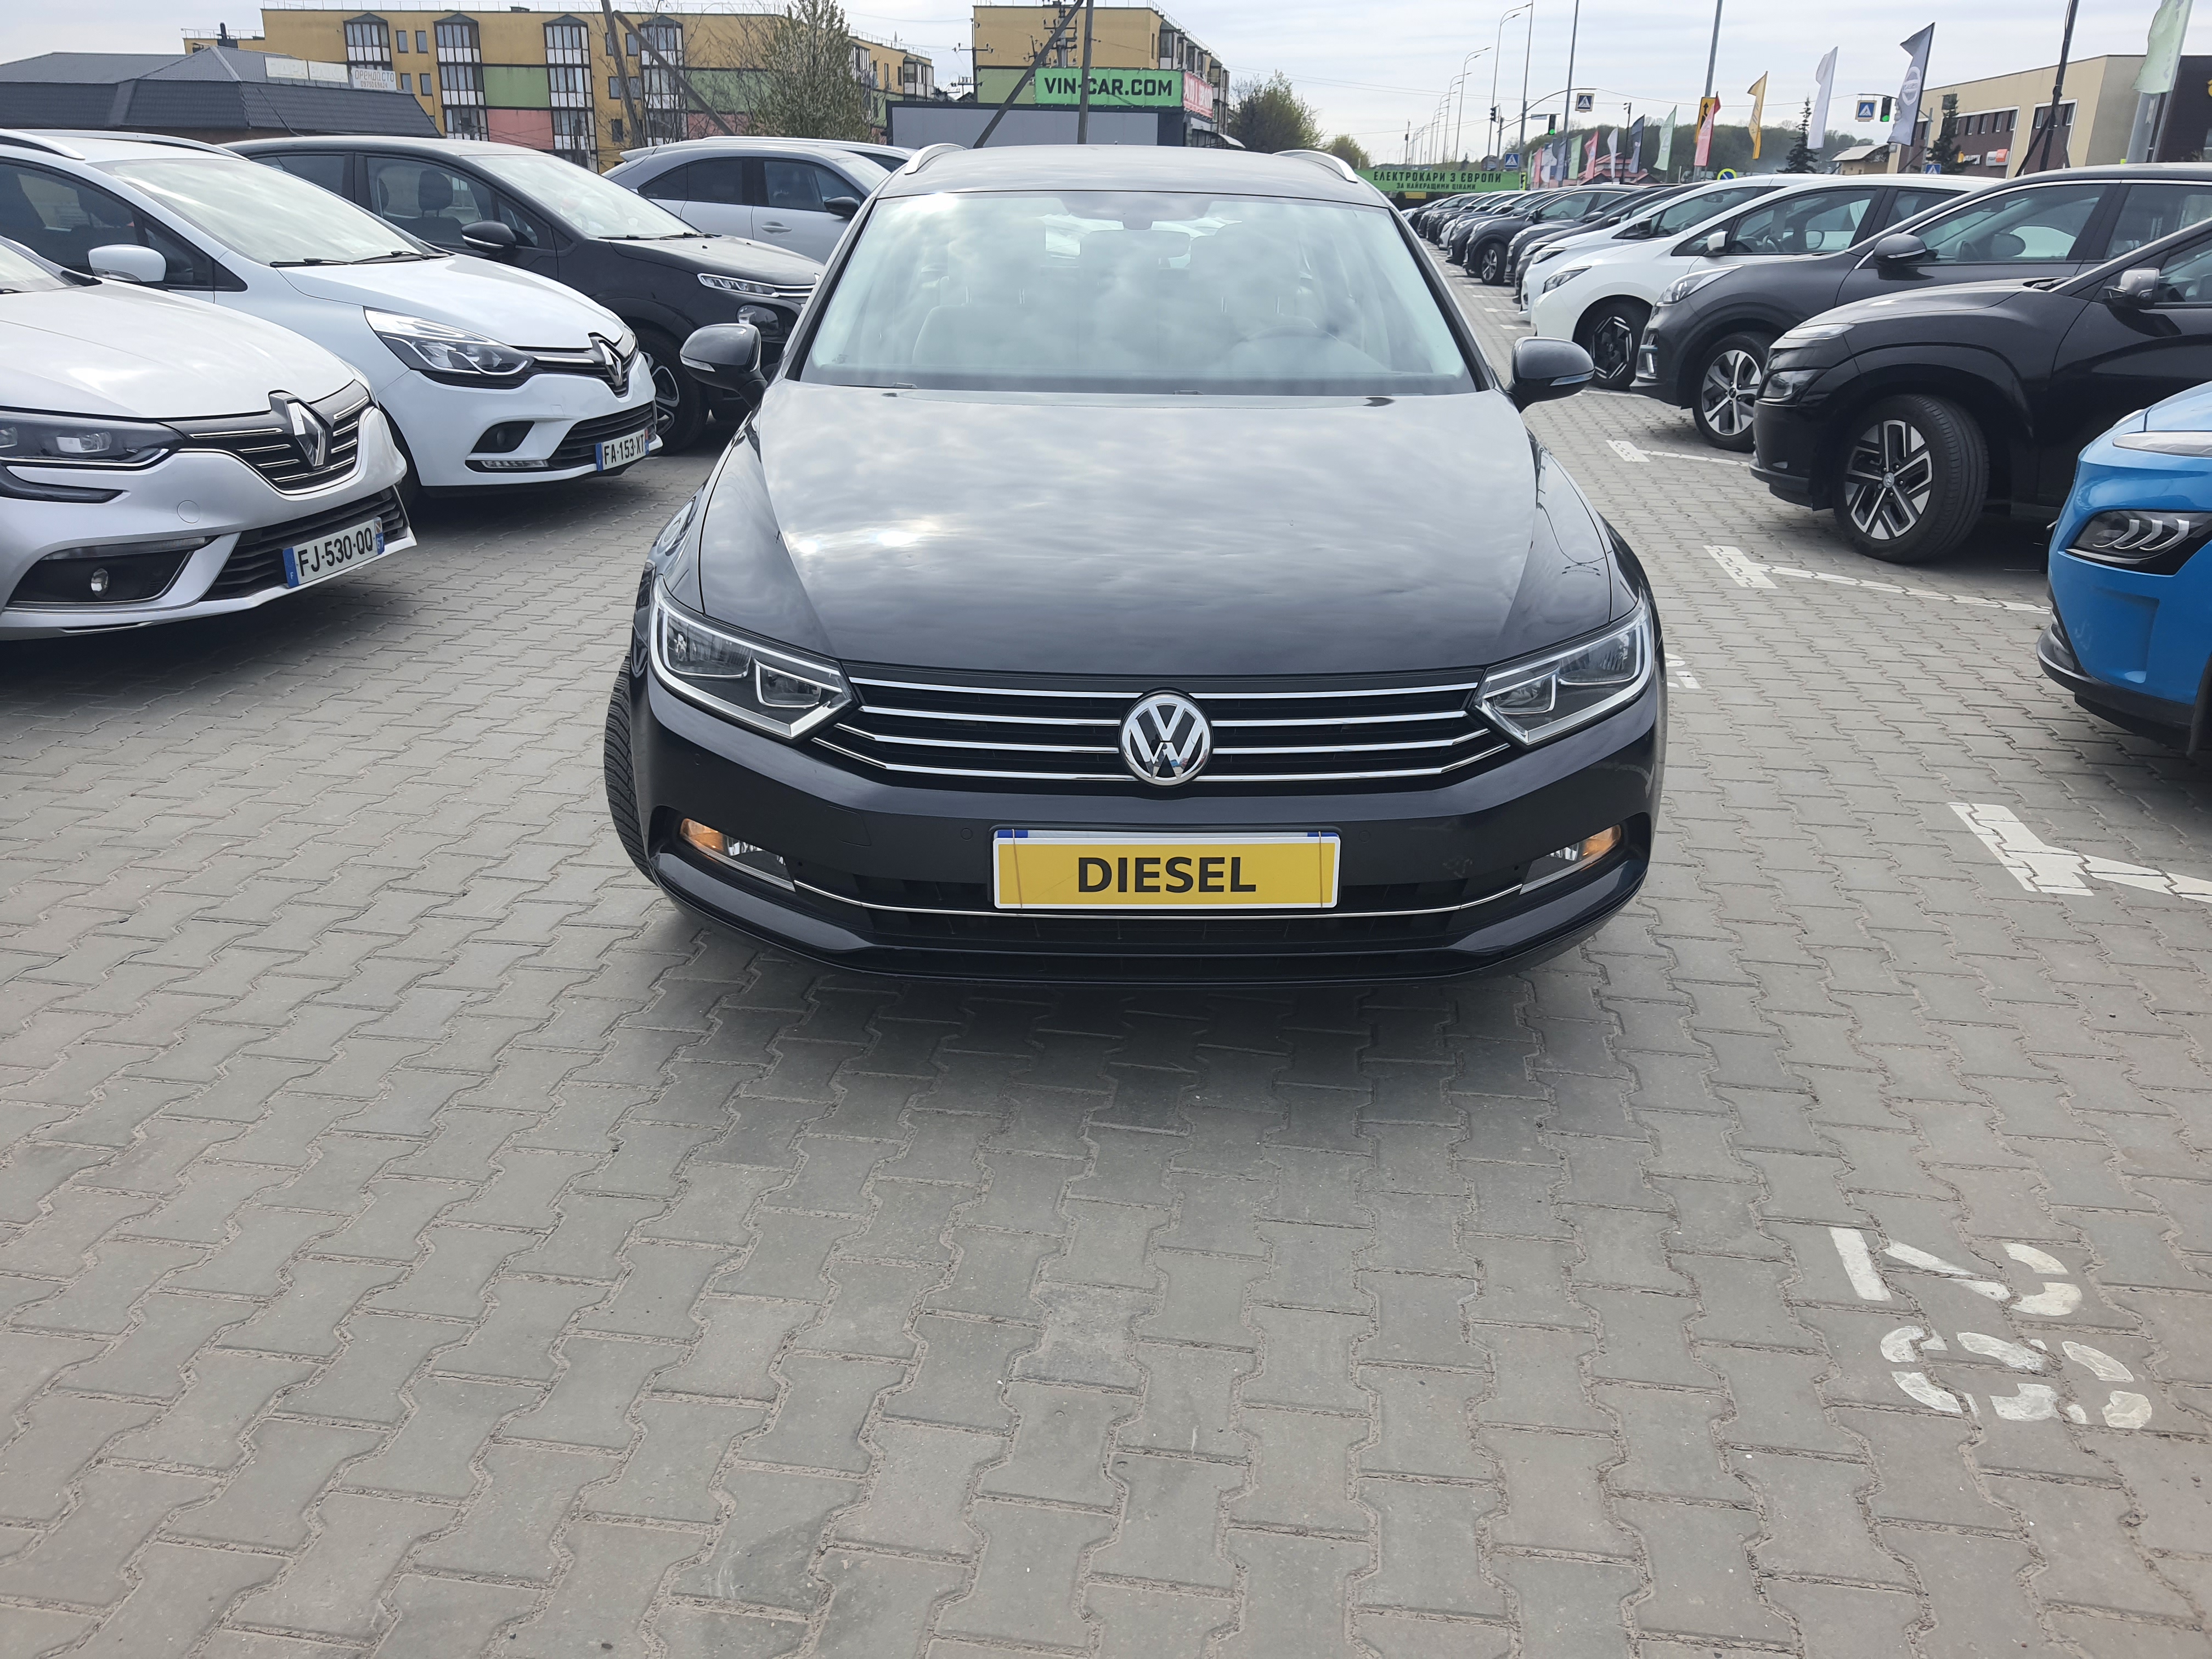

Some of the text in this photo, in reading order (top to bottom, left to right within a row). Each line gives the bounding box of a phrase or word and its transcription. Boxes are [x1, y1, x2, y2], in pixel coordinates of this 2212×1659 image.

[1045, 77, 1172, 96] VIN-CAR.COM
[1374, 171, 1446, 183] ЕЛЕКТРОКАРИ
[1460, 172, 1502, 183] ЄВРОПИ
[1407, 182, 1449, 190] НАЙКРАЩИМИ
[376, 536, 383, 549] 67
[1078, 857, 1256, 893] DIESEL
